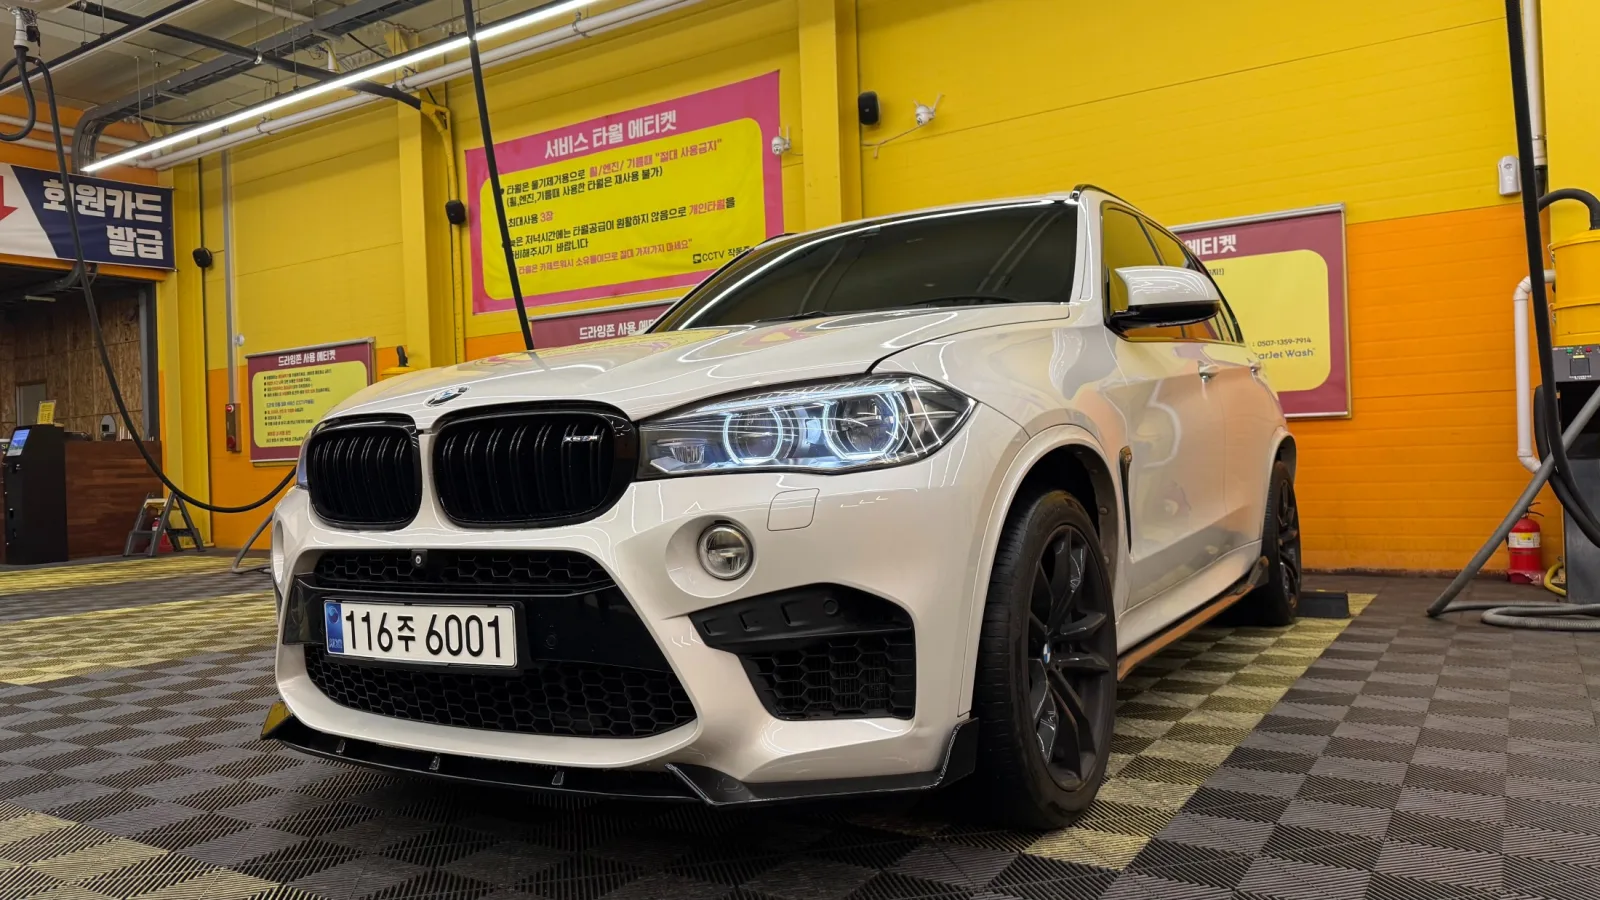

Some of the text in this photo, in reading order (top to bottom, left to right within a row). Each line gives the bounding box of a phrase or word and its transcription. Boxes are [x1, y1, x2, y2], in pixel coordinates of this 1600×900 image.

[544, 109, 677, 159] 서비스 타월 에티켓
[506, 181, 529, 196] 타월은
[531, 168, 586, 189] 물기제거용으로
[681, 138, 722, 159] 사용금지"
[562, 183, 586, 197] 사용한
[588, 176, 613, 191] 타월은
[615, 170, 639, 185] 재사용
[641, 165, 663, 180] 불가)
[43, 178, 163, 223] 회원카드
[508, 211, 554, 228] 최대사용 3장
[525, 228, 571, 245] 저녁시간에는
[573, 220, 615, 237] 타월공급이
[616, 213, 649, 229] 원활하지
[651, 206, 687, 222] 않음으로
[689, 196, 735, 217] 개인타월을
[106, 225, 164, 260] 발급
[512, 238, 589, 260] 비해주시기 바랍니다
[666, 238, 692, 253] 마세요"
[702, 250, 725, 262] CCTV
[579, 322, 616, 340] 드라잉존
[617, 321, 637, 336] 사용
[303, 352, 316, 364] 사용
[316, 349, 336, 362] 에티켓
[1255, 350, 1283, 360] arJet
[345, 610, 501, 658] 116주 6001
